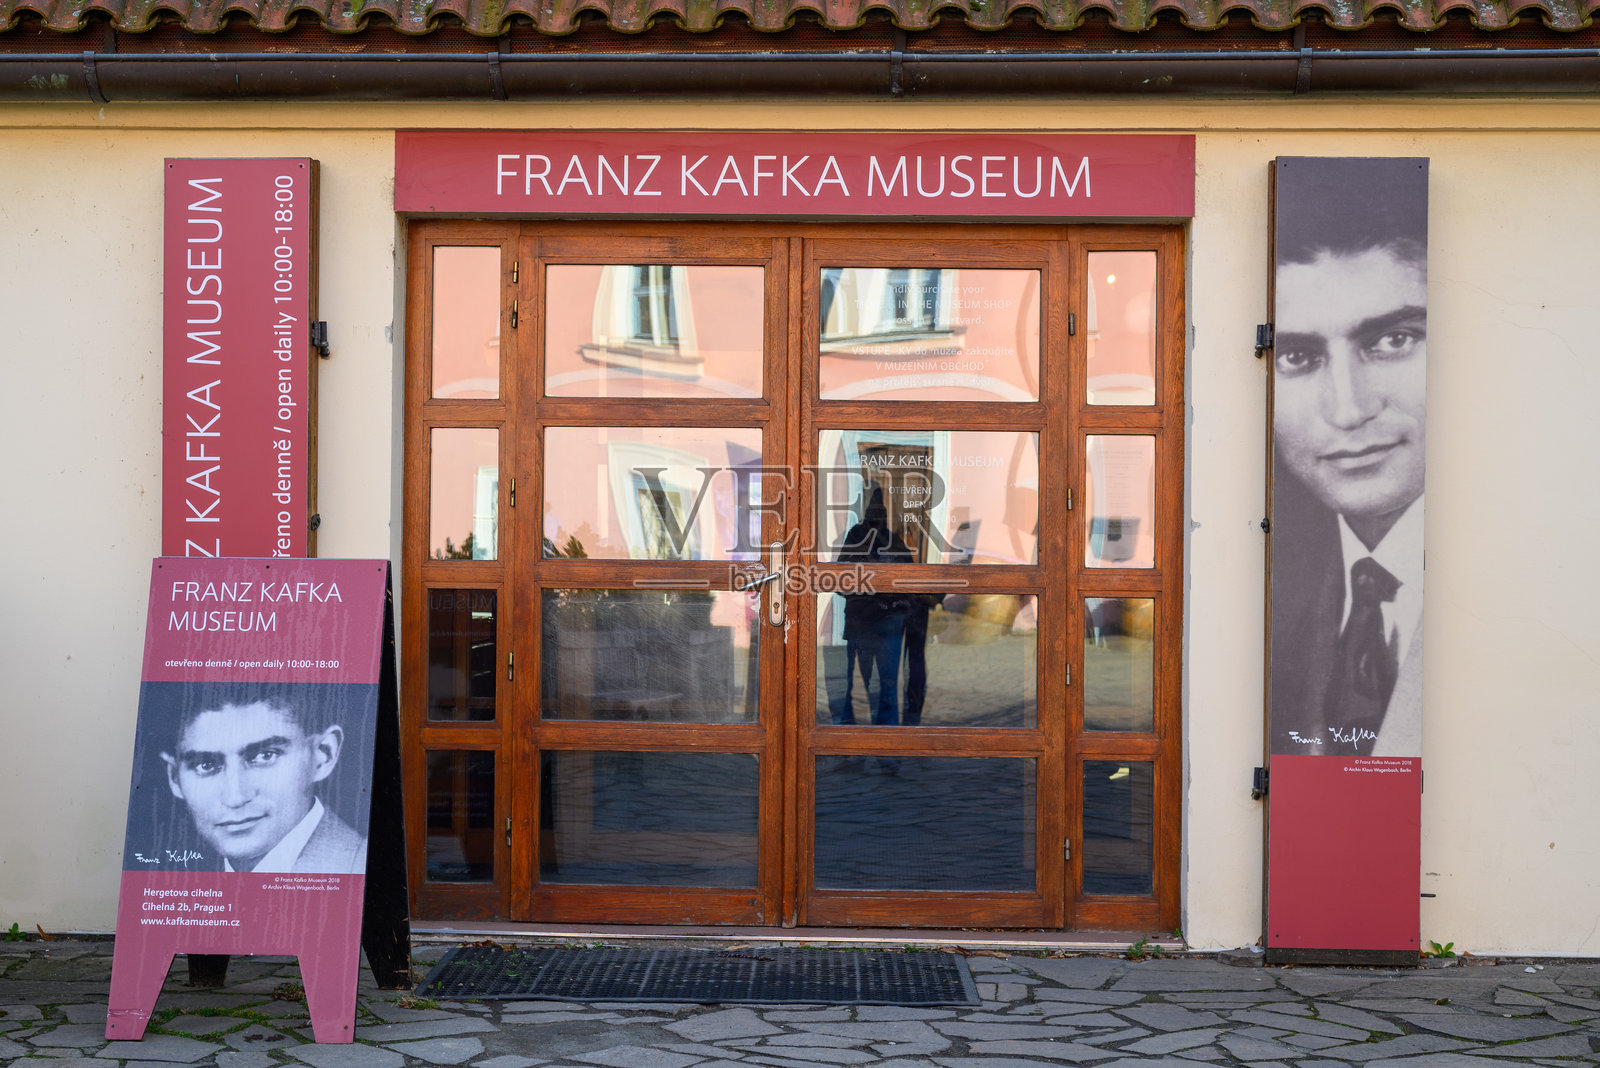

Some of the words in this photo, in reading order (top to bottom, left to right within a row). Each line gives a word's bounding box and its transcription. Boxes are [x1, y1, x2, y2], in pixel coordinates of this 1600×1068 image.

[496, 154, 662, 196] FRANZ
[680, 155, 850, 197] KAFKA
[867, 155, 1091, 198] MUSEUM
[274, 175, 294, 304] 10:00-18:00
[187, 177, 223, 366] MUSEUM
[983, 300, 1012, 310] SHOP
[272, 311, 298, 362] daily
[941, 361, 985, 371] OBCHOD
[277, 368, 297, 421] open
[185, 379, 221, 523] KAFKA
[272, 439, 292, 505] denně
[272, 510, 291, 557] řeno
[171, 581, 253, 602] FRANZ
[260, 582, 343, 603] KAFKA
[168, 610, 276, 632] MUSEUM
[164, 658, 203, 668] otevřeno
[205, 659, 232, 668] denně
[239, 660, 261, 669] open
[263, 660, 284, 670] daily
[286, 660, 340, 669] 10:00-18:00
[141, 901, 176, 911] Cihelná
[177, 902, 192, 913] 2b,
[193, 903, 226, 914] Prague
[143, 887, 189, 899] Hergetova
[190, 888, 223, 898] cihelna
[140, 917, 241, 927] www.kafkamuseum.cz
